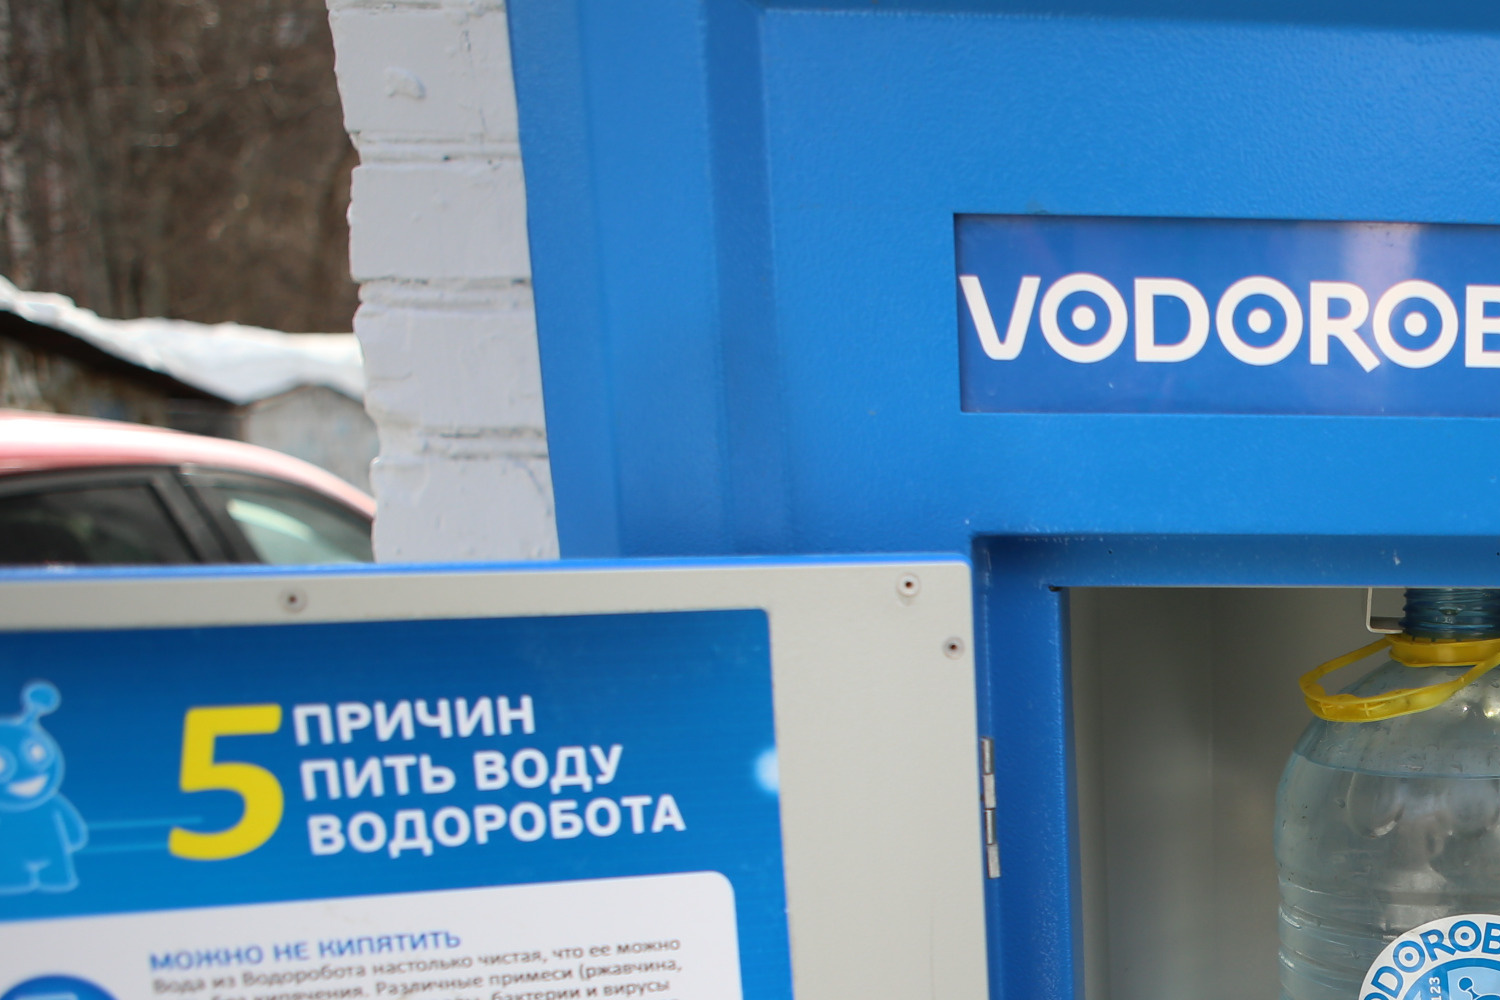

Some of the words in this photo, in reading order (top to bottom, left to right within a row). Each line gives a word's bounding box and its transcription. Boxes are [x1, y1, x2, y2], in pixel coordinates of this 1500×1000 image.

[292, 694, 536, 746] ПРИЧИН
[168, 704, 285, 860] 5
[300, 753, 457, 801] ПИТЬ
[473, 744, 623, 795] ВОДУ
[307, 793, 687, 858] ВОДОРОБОТА
[148, 944, 265, 971] МОЖНО
[270, 941, 309, 961] НЕ
[316, 929, 461, 957] КИПЯТИТЬ
[584, 986, 598, 998] и
